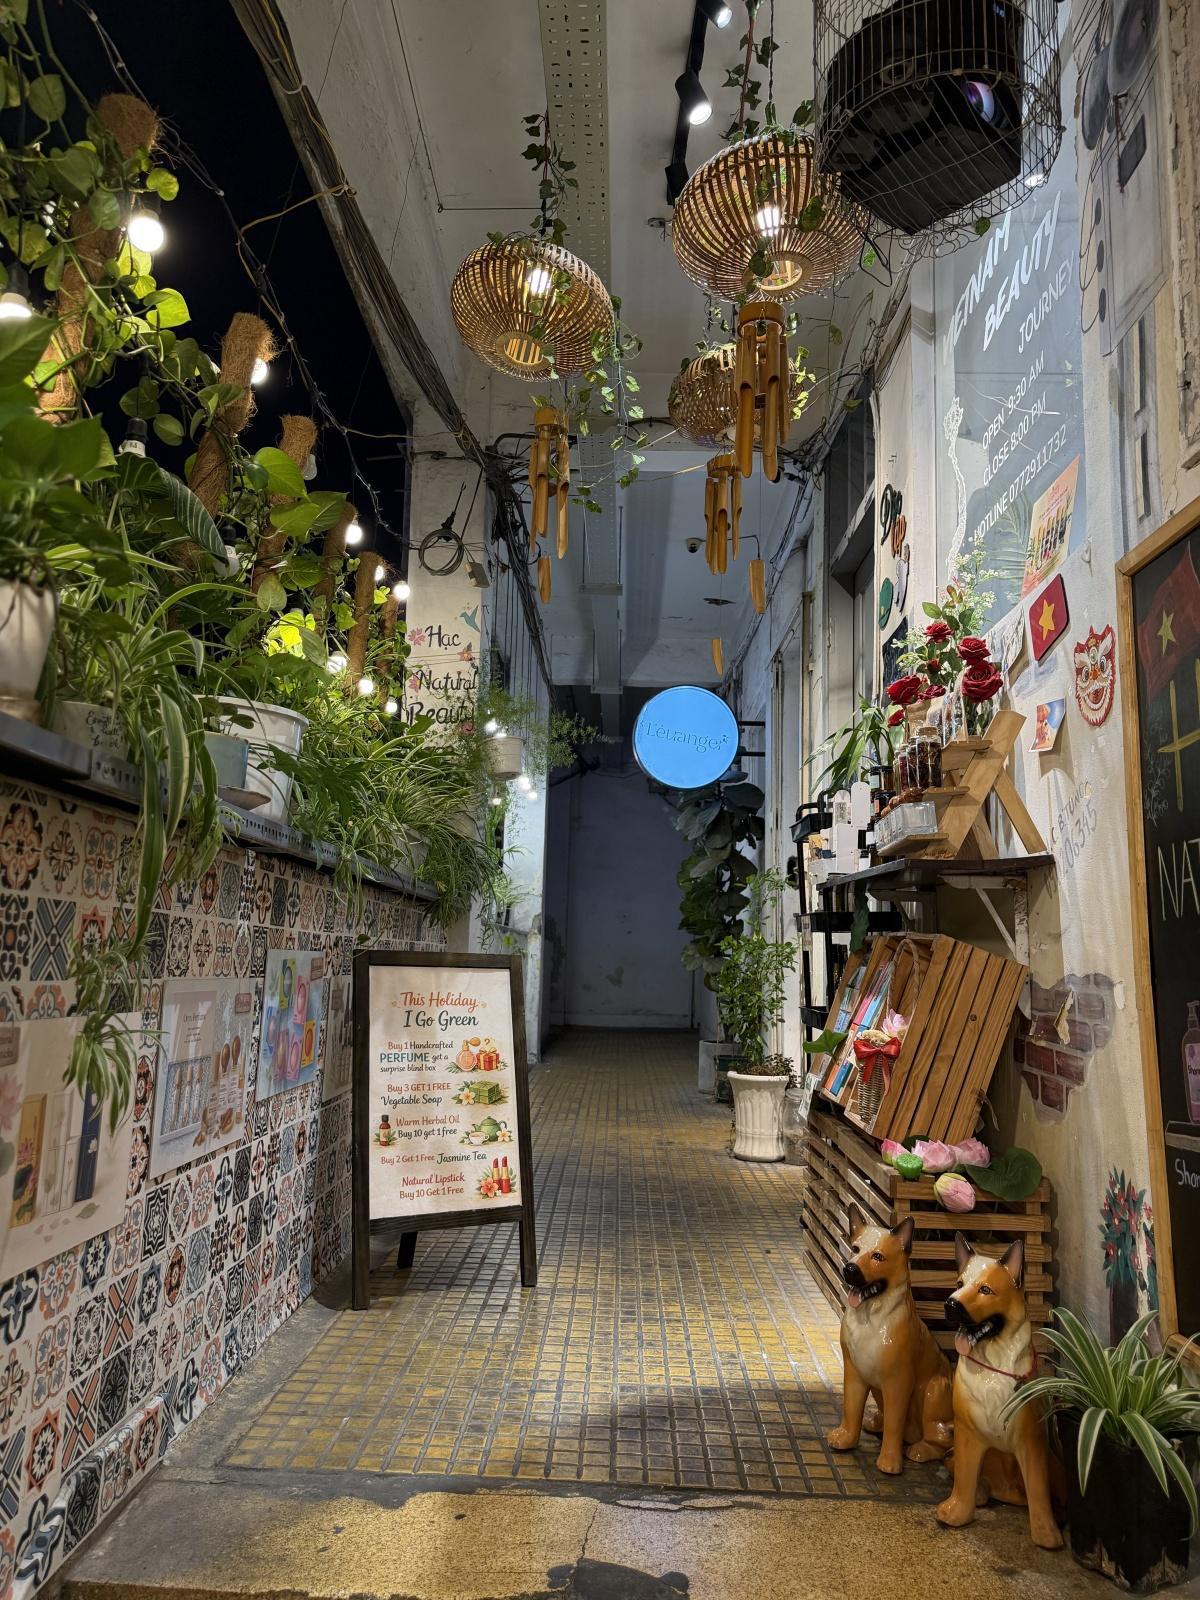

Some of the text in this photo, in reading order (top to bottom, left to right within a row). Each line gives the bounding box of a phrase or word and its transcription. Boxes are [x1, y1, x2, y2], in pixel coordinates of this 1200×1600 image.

[983, 190, 1062, 351] BEAUTY
[1018, 250, 1075, 353] JOURNEY
[982, 350, 1045, 450] OPEN 9:30 AM
[983, 392, 1047, 487] CLOSE 8:00 PM
[974, 491, 1008, 543] HOTLINE
[1009, 424, 1067, 502] 0772911732
[425, 624, 462, 650] Hạc
[413, 666, 478, 691] Natural
[401, 991, 479, 1013] This Holiday
[403, 1010, 479, 1031] I Go Green
[387, 1041, 454, 1052] Buy 1 Handcrafted
[379, 1052, 430, 1063] PERFUME
[432, 1053, 442, 1062] get
[380, 1064, 437, 1075] surprise blind box
[387, 1082, 452, 1095] Buy 3 GET 1 FREE
[380, 1094, 443, 1109] Vegetable Soap
[396, 1114, 460, 1127] Warm Herbal Oil
[398, 1128, 458, 1140] Buy 10 get 1 free
[381, 1156, 395, 1166] Buy
[396, 1155, 401, 1163] 2
[402, 1155, 415, 1163] Get
[416, 1154, 420, 1162] 1
[437, 1152, 471, 1164] Jasmine
[472, 1151, 488, 1160] Tea
[402, 1172, 466, 1187] Natural Lipstick
[400, 1191, 415, 1200] Buy
[416, 1190, 425, 1198] 10
[426, 1189, 442, 1197] Get
[447, 1187, 464, 1195] Free
